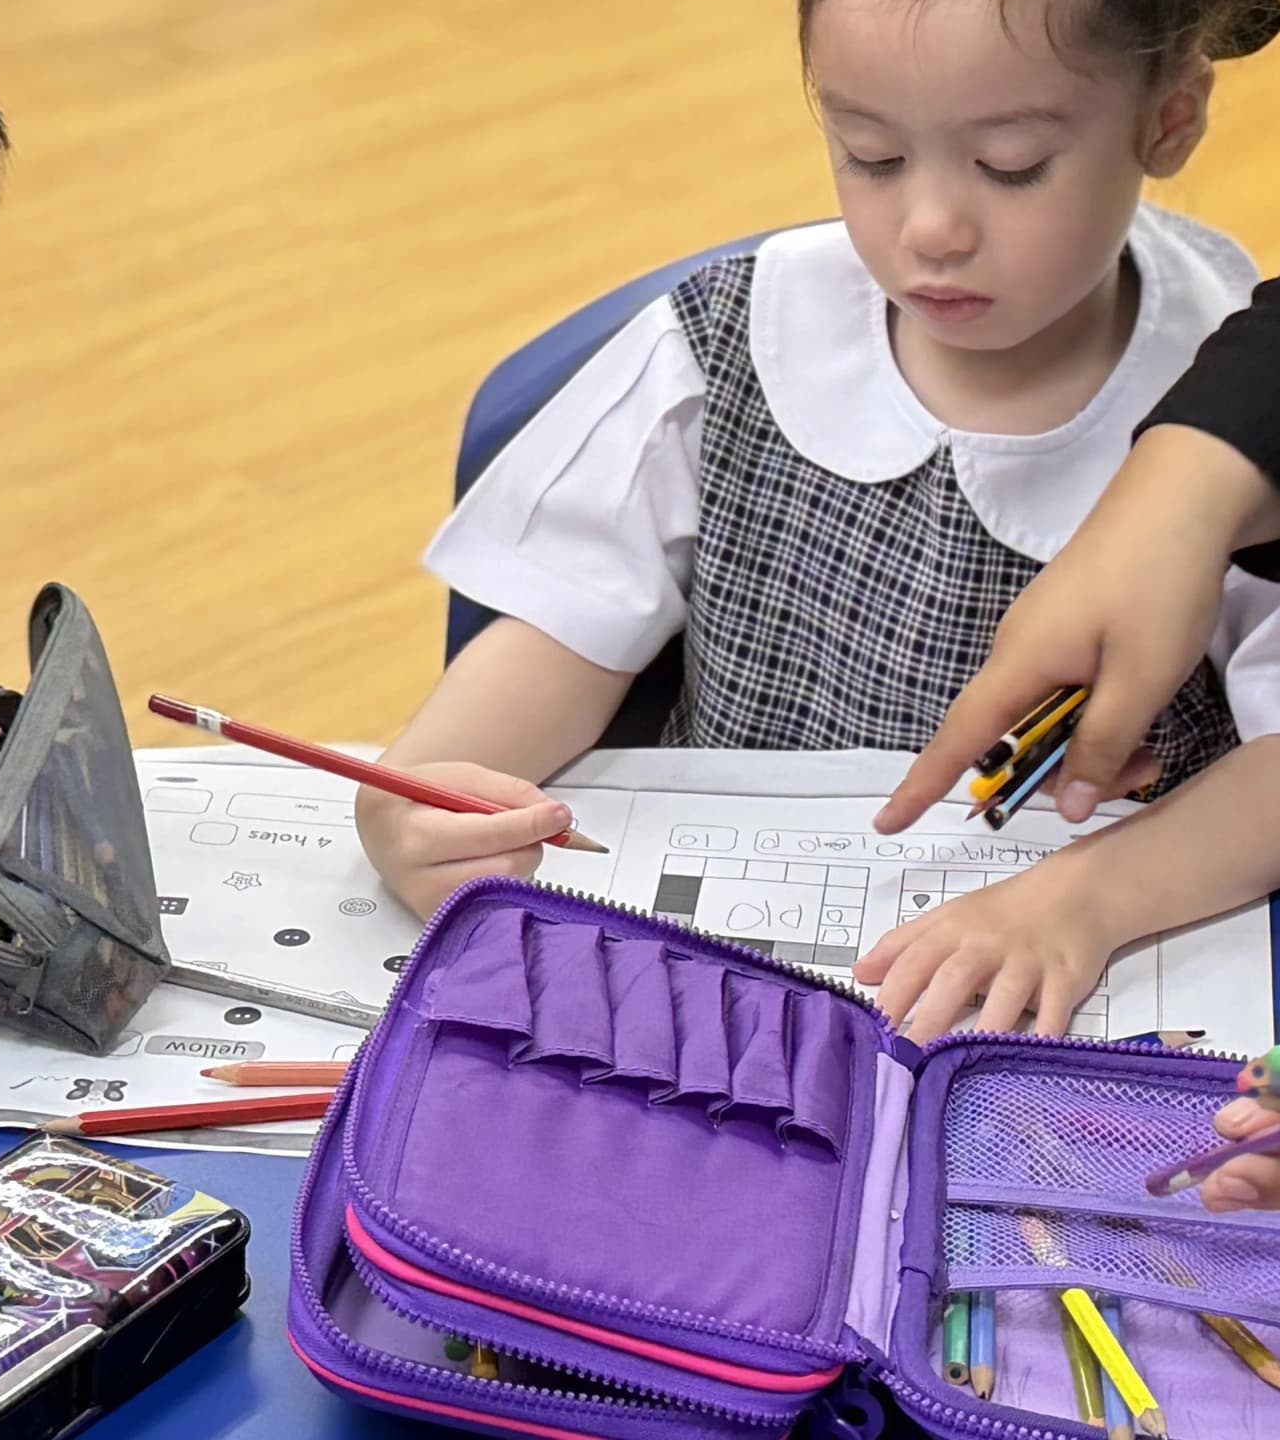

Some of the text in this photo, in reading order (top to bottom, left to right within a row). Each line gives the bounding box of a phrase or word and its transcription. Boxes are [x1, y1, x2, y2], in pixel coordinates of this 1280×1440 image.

[248, 829, 333, 849] 4 holes
[164, 1041, 248, 1059] yellow
